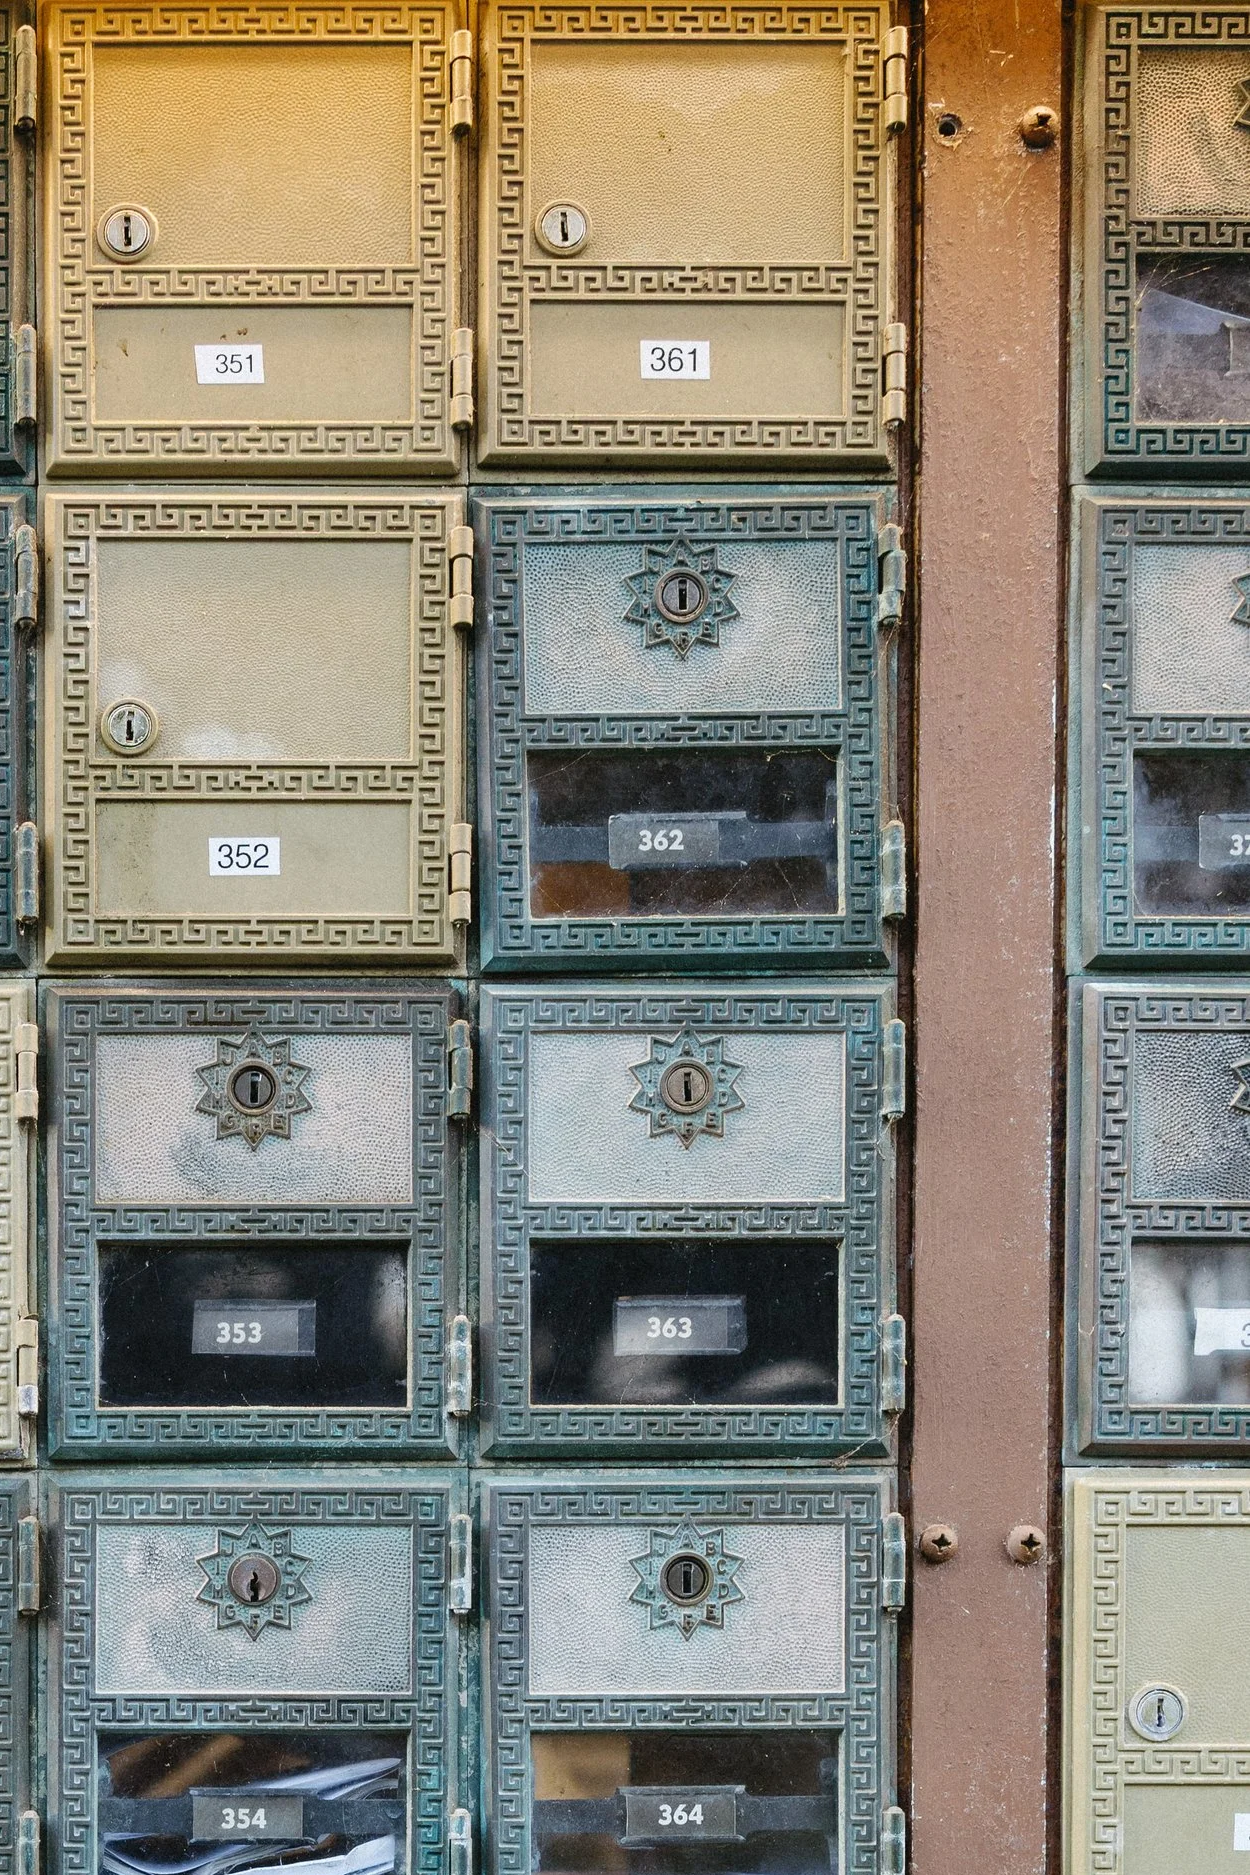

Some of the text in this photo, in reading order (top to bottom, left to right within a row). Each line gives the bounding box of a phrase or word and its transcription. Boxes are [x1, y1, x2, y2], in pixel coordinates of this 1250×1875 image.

[216, 354, 252, 373] 351
[651, 347, 696, 371] 361
[639, 829, 684, 851] 362
[218, 844, 269, 868] 352
[217, 1322, 263, 1343] 353
[647, 1317, 692, 1339] 363
[221, 1808, 266, 1829] 354
[659, 1804, 703, 1825] 364
